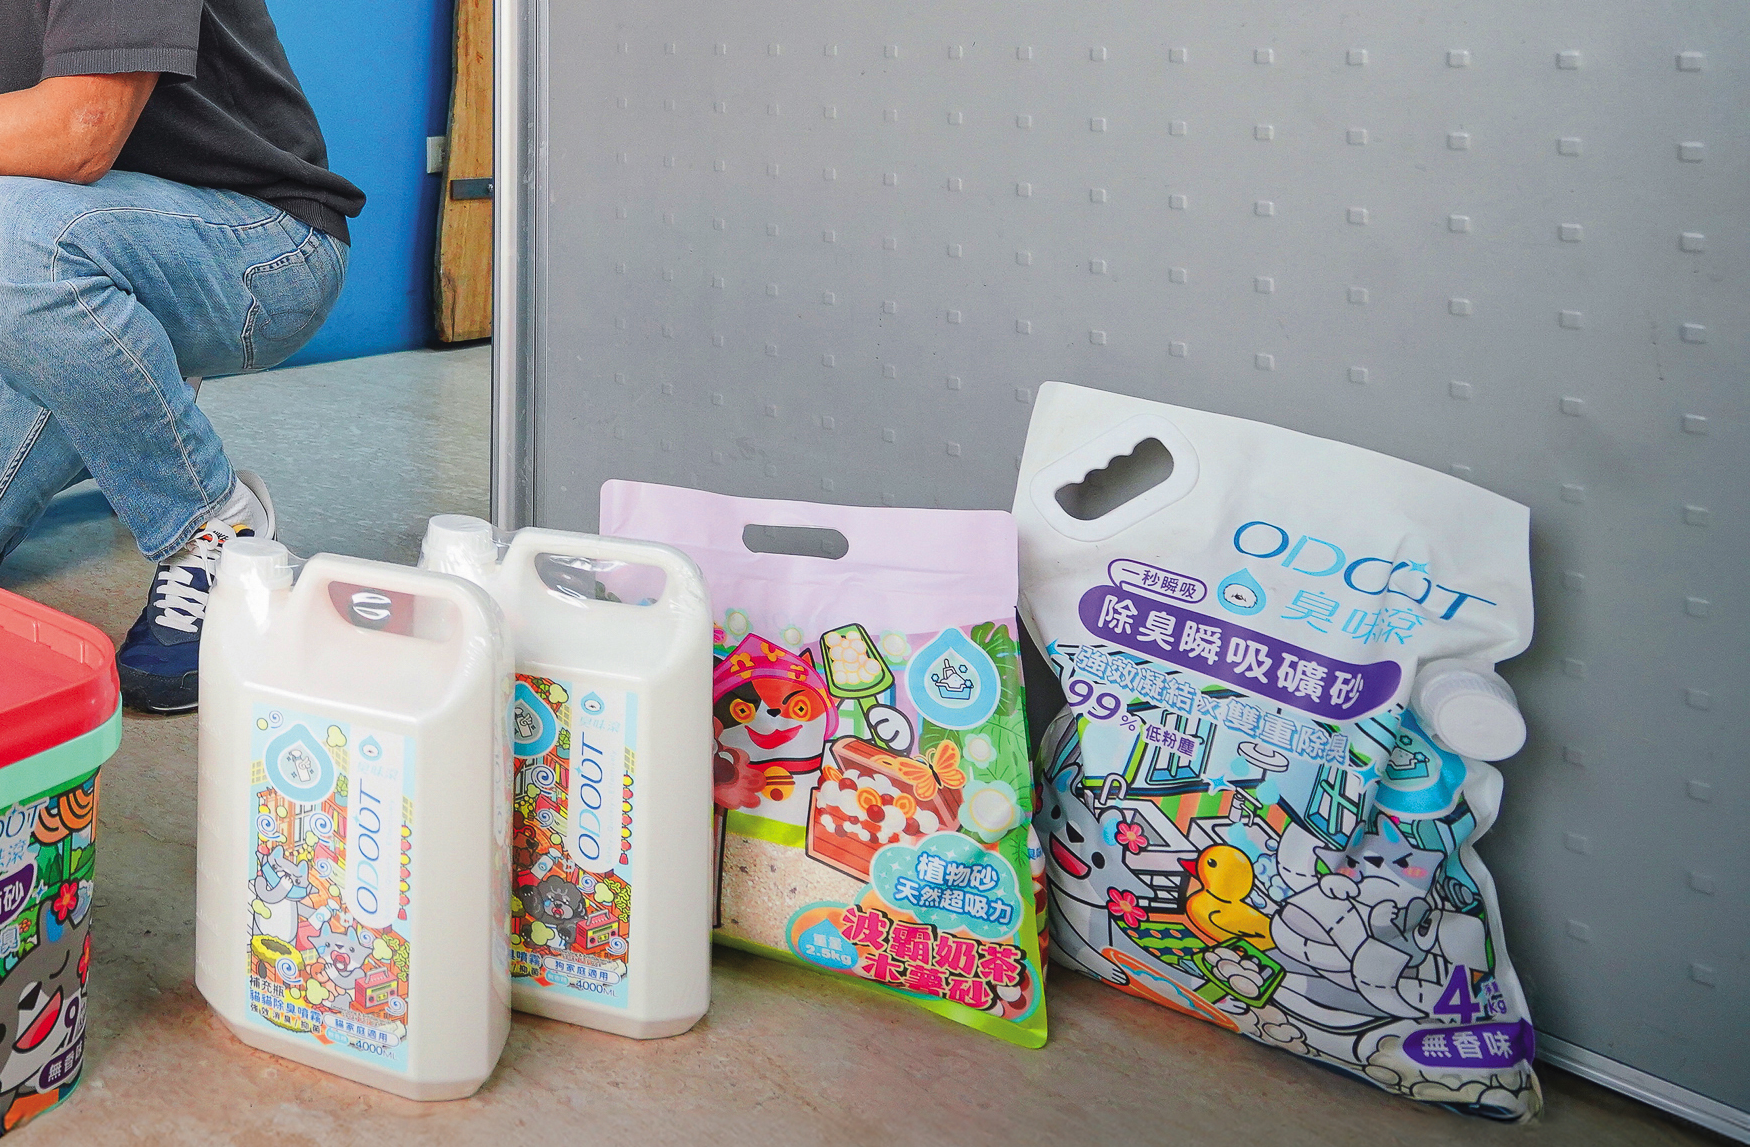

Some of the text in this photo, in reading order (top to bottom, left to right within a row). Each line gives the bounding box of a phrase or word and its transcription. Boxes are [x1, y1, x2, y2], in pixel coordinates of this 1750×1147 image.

[1121, 567, 1199, 601] 一秒瞬吸
[1096, 594, 1366, 712] 除臭瞬吸礦砂
[578, 731, 604, 861] ODOUT
[356, 778, 382, 915] ODOUT
[916, 852, 999, 893] 植物砂
[894, 876, 1013, 926] 天然超吸力
[805, 944, 852, 966] 2.5kg
[841, 907, 1022, 985] 波霸奶茶
[250, 975, 285, 998] 補充瓶
[554, 960, 609, 981] 狗家庭適用
[250, 989, 322, 1025] 貓貓除臭噴霧
[1433, 964, 1481, 1024] 4
[334, 1018, 388, 1044] 貓家庭適用
[1421, 1031, 1514, 1059] 無香味
